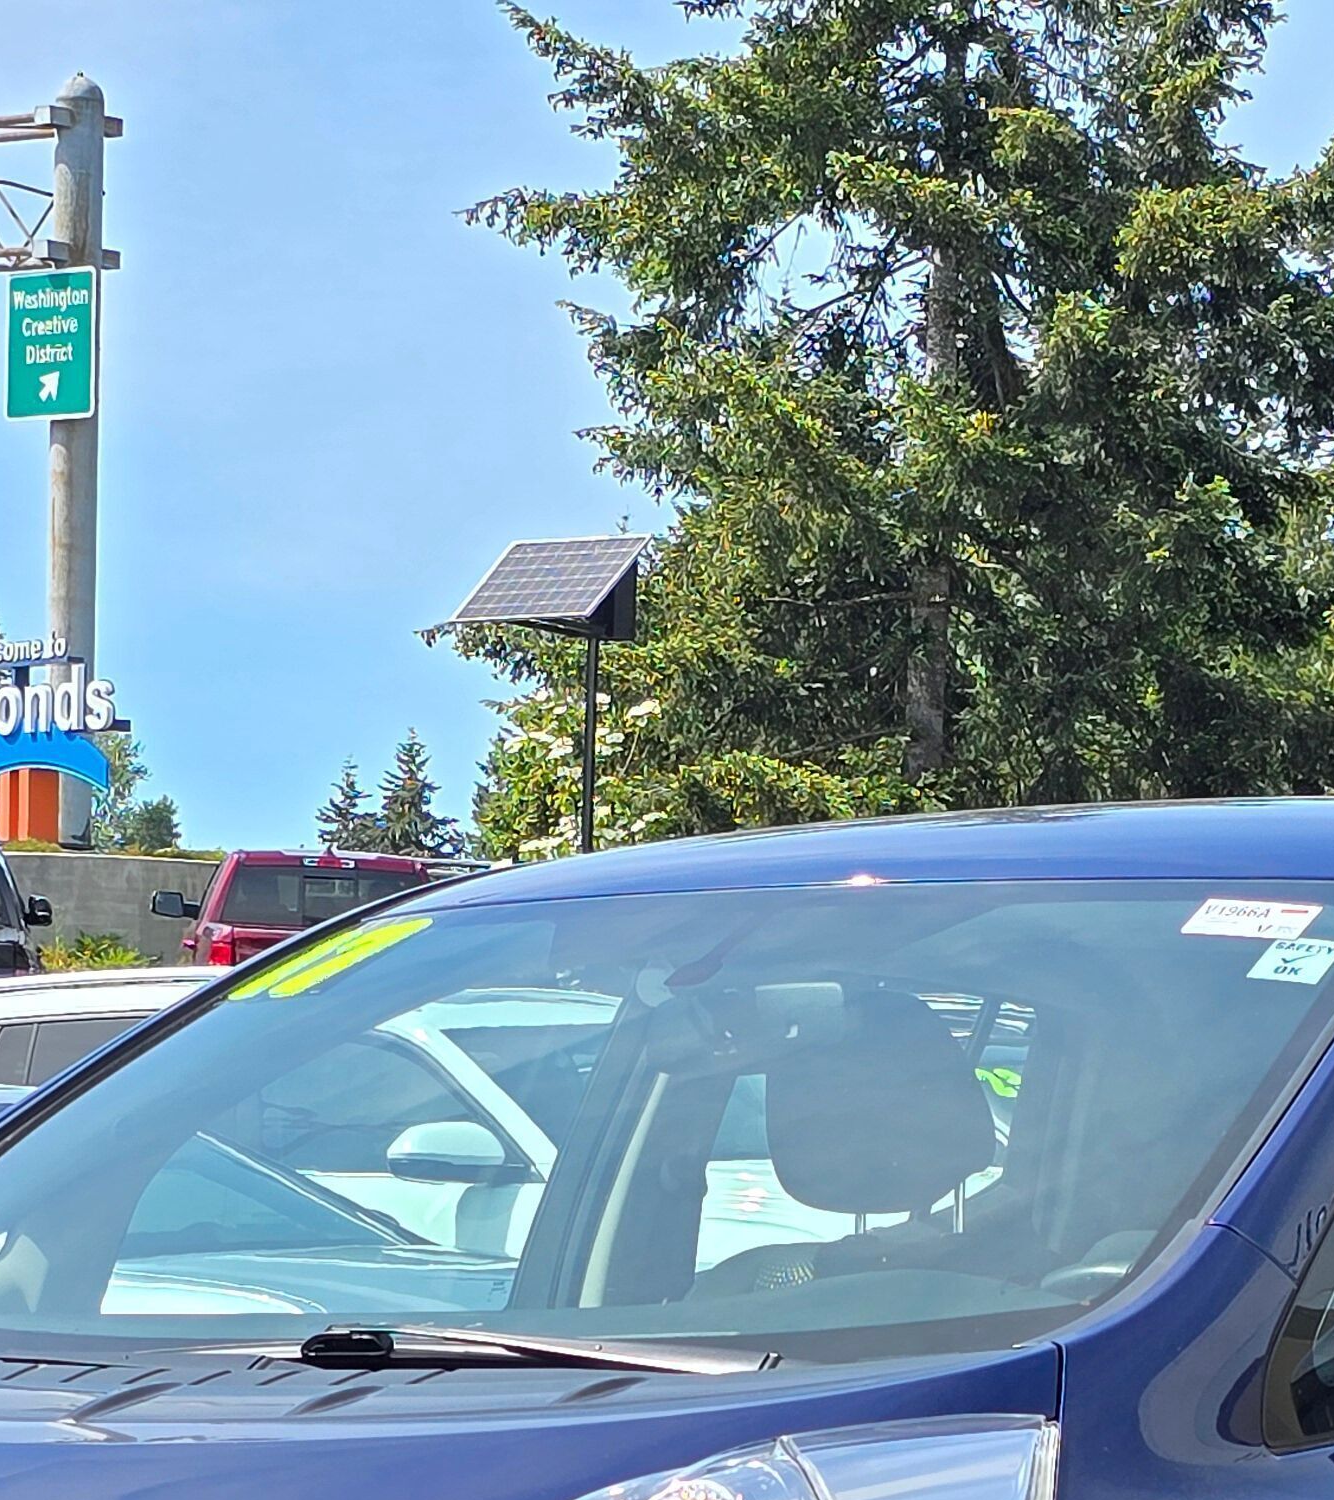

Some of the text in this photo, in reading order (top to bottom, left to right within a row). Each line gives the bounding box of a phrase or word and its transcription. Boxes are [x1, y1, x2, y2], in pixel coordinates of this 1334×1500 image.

[13, 286, 88, 312] Washington
[22, 315, 79, 337] Creative
[26, 342, 73, 364] District
[43, 632, 67, 659] to
[1273, 965, 1304, 976] OK
